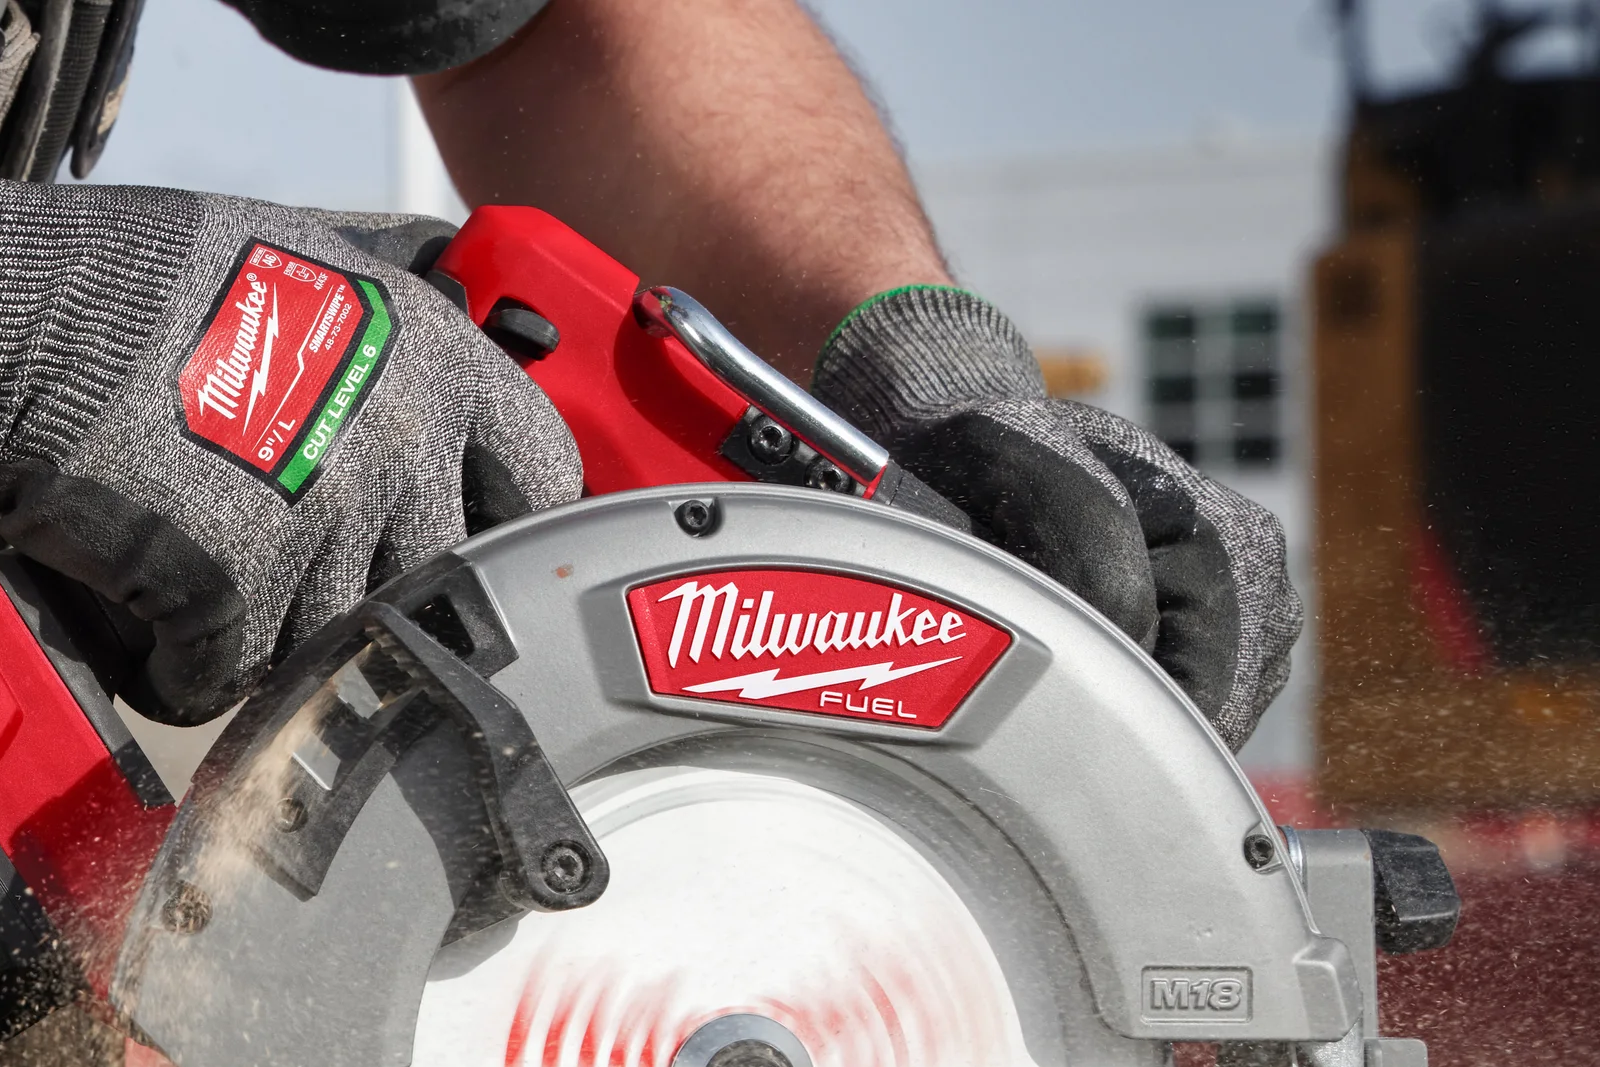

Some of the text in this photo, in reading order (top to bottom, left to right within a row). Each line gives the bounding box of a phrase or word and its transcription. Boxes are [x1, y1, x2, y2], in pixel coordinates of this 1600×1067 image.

[262, 254, 277, 267] A6
[313, 272, 328, 290] 4X43F
[324, 303, 352, 351] 48-73-7002
[303, 344, 377, 460] CUT LEVEL 6
[658, 580, 966, 668] Milwaukee
[819, 691, 917, 719] FUEL
[1151, 978, 1243, 1011] M18
